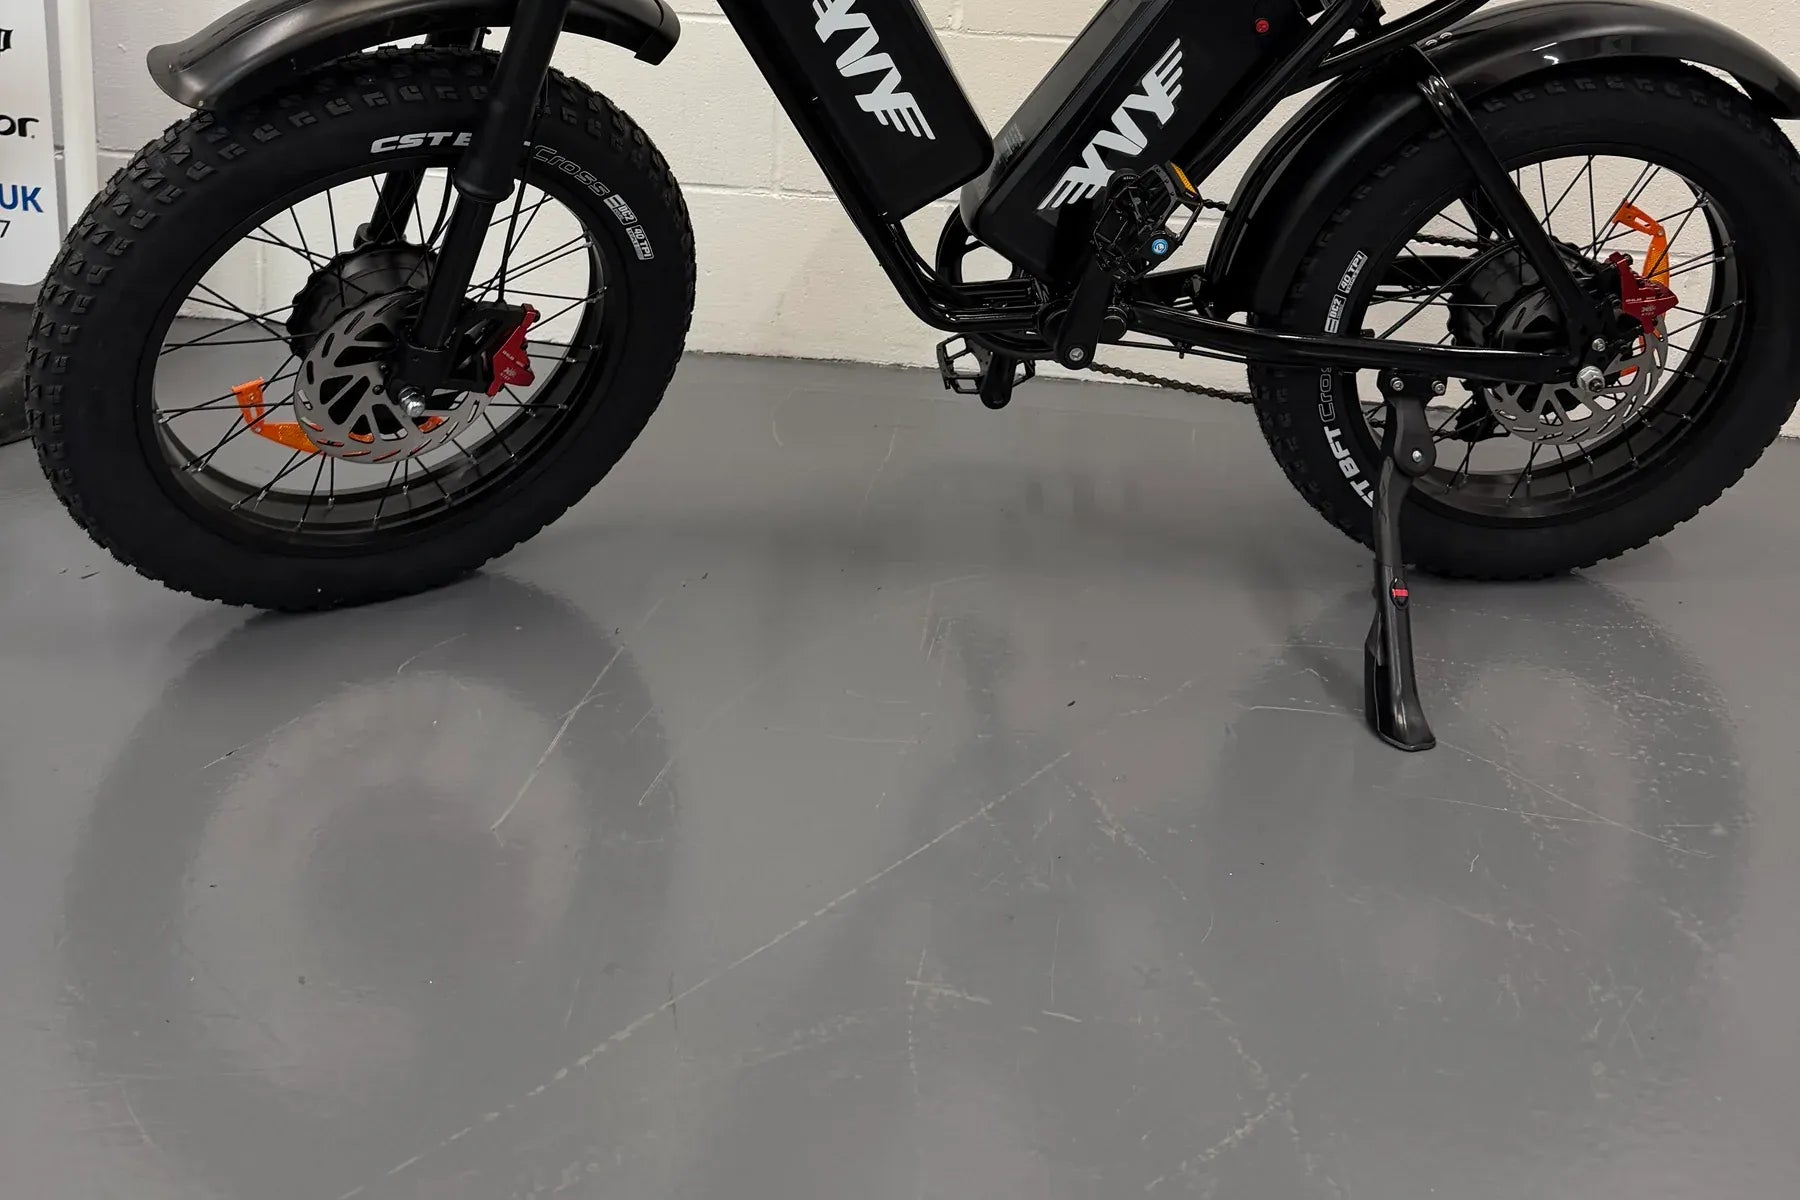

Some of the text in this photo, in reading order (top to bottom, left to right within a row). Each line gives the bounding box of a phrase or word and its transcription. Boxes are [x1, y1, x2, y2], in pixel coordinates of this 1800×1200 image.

[370, 131, 454, 154] CST
[532, 144, 611, 197] Cross
[639, 239, 652, 259] TPI
[1349, 253, 1363, 272] TPI
